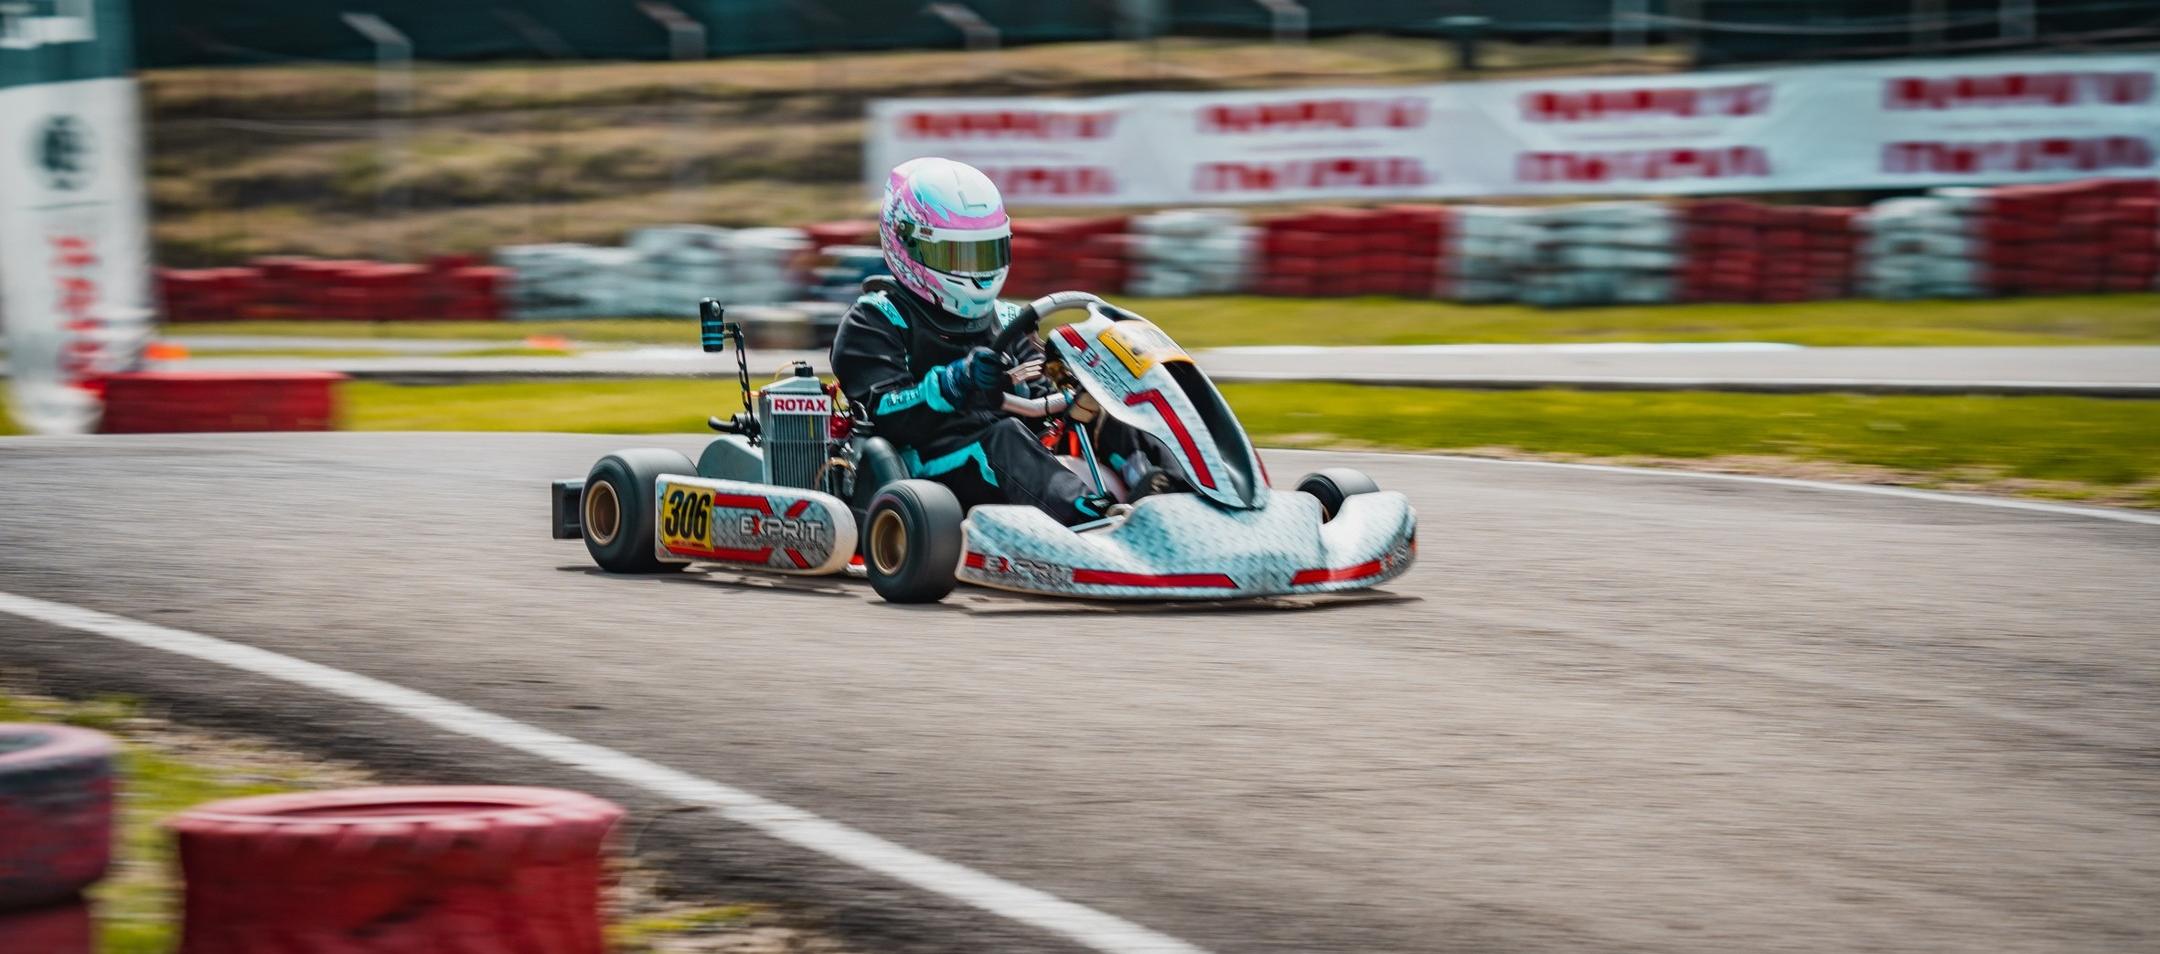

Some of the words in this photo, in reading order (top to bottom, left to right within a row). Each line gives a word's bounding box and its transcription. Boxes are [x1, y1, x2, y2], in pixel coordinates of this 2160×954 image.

[774, 398, 826, 411] ROTAX
[665, 490, 711, 540] 306
[740, 515, 821, 541] EXPRIT
